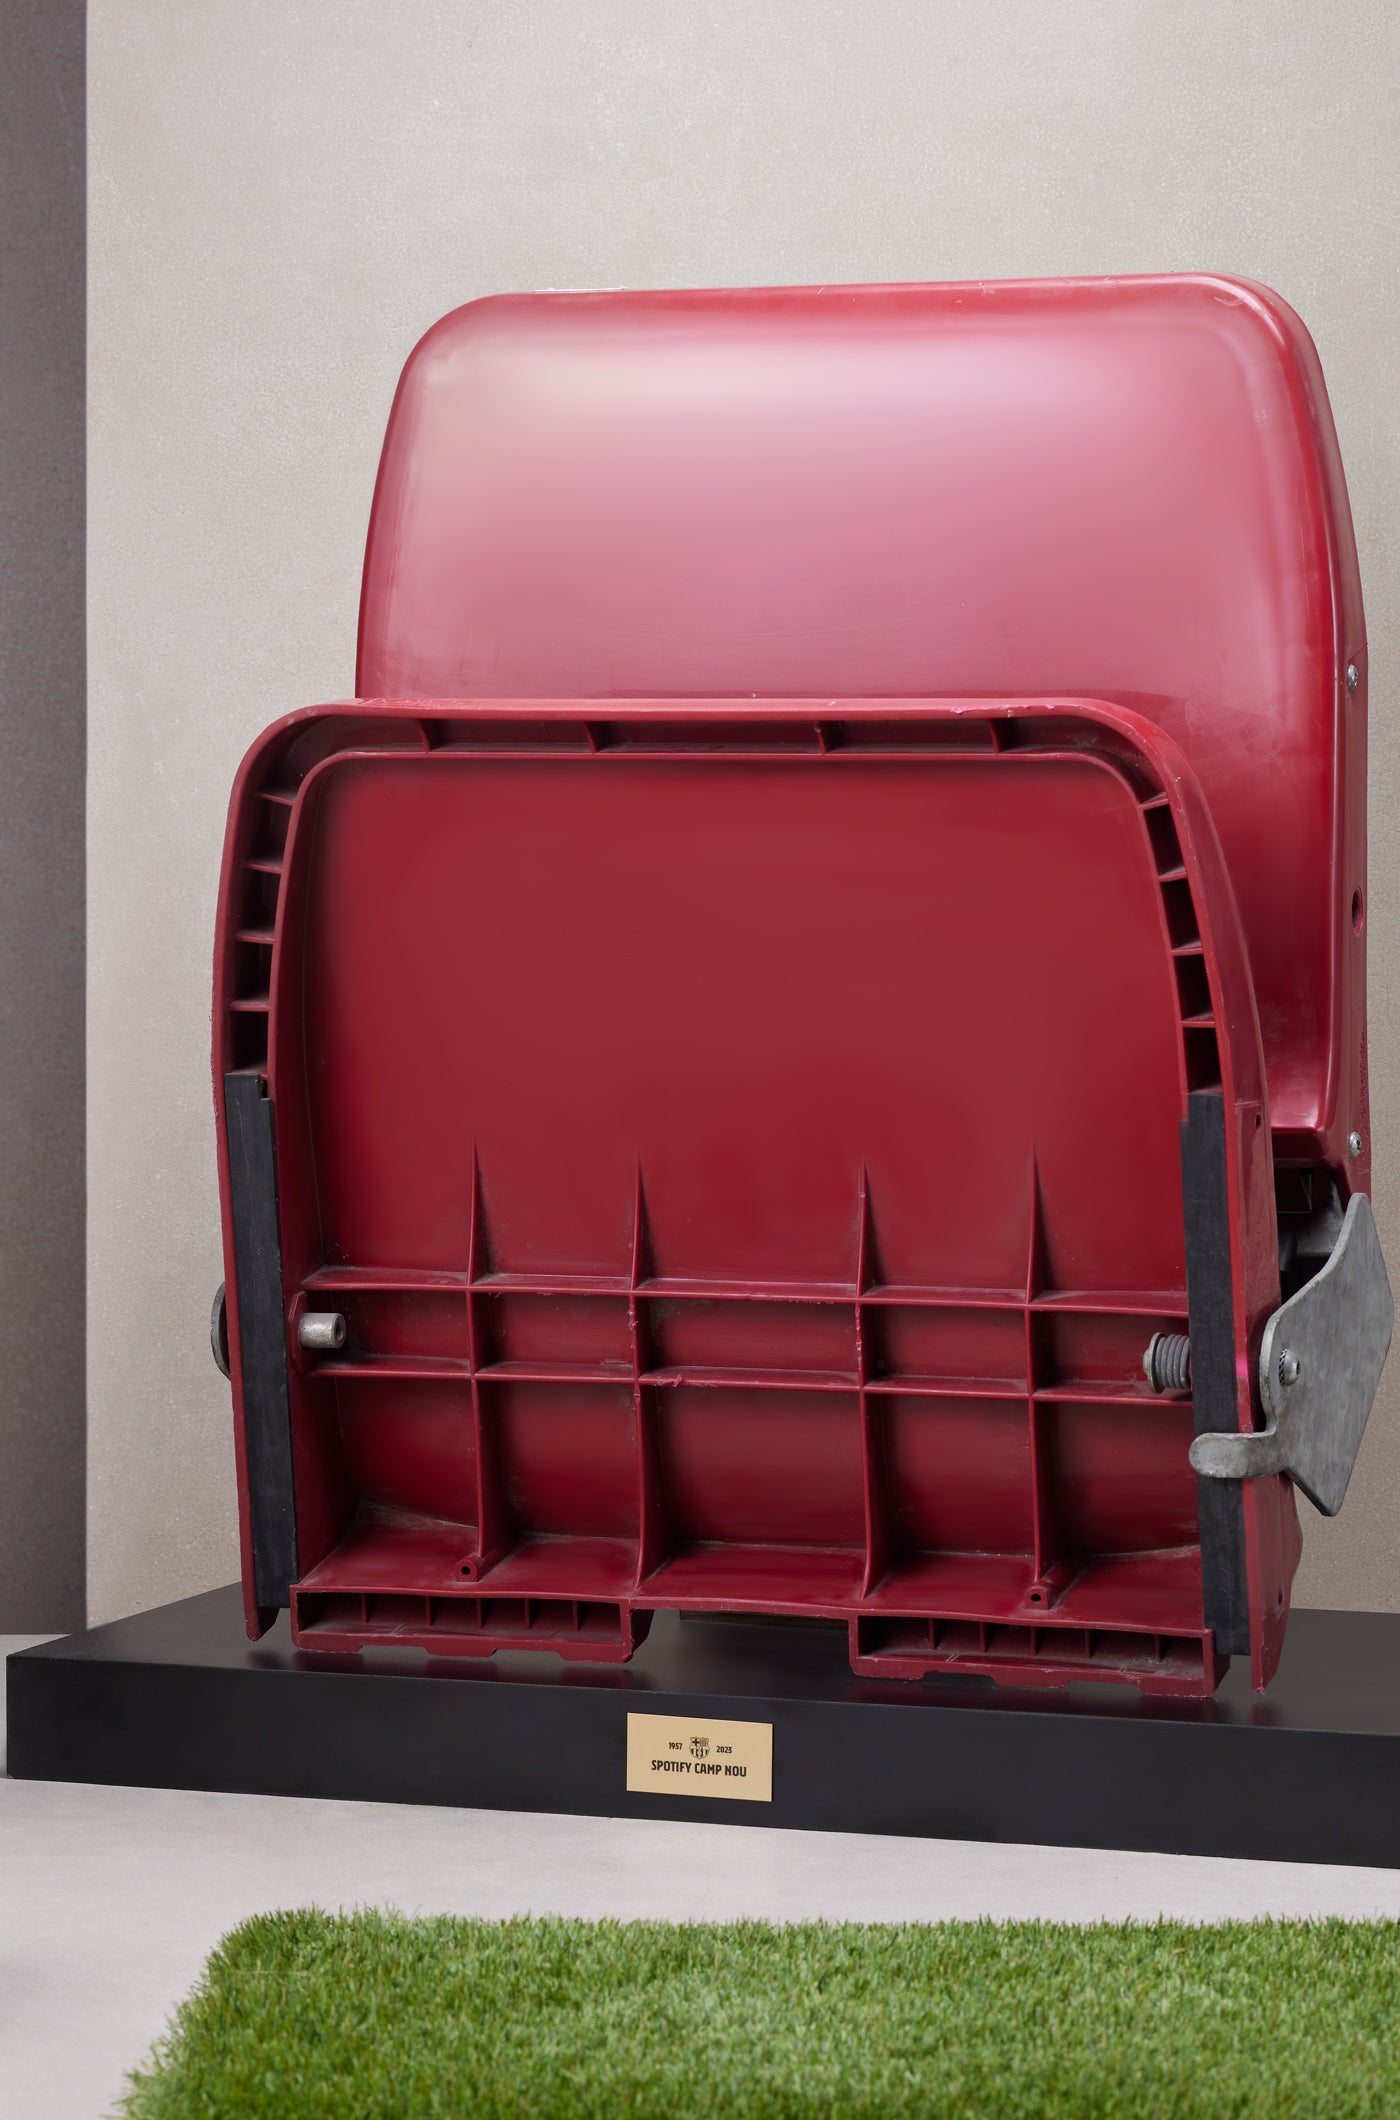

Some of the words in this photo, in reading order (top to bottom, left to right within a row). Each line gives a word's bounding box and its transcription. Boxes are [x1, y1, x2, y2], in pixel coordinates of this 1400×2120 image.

[668, 1742, 683, 1750] 1957
[716, 1745, 732, 1754] 2023
[651, 1760, 692, 1773] SPOTIFY
[694, 1763, 721, 1775] CAMP
[724, 1765, 747, 1777] NOU
